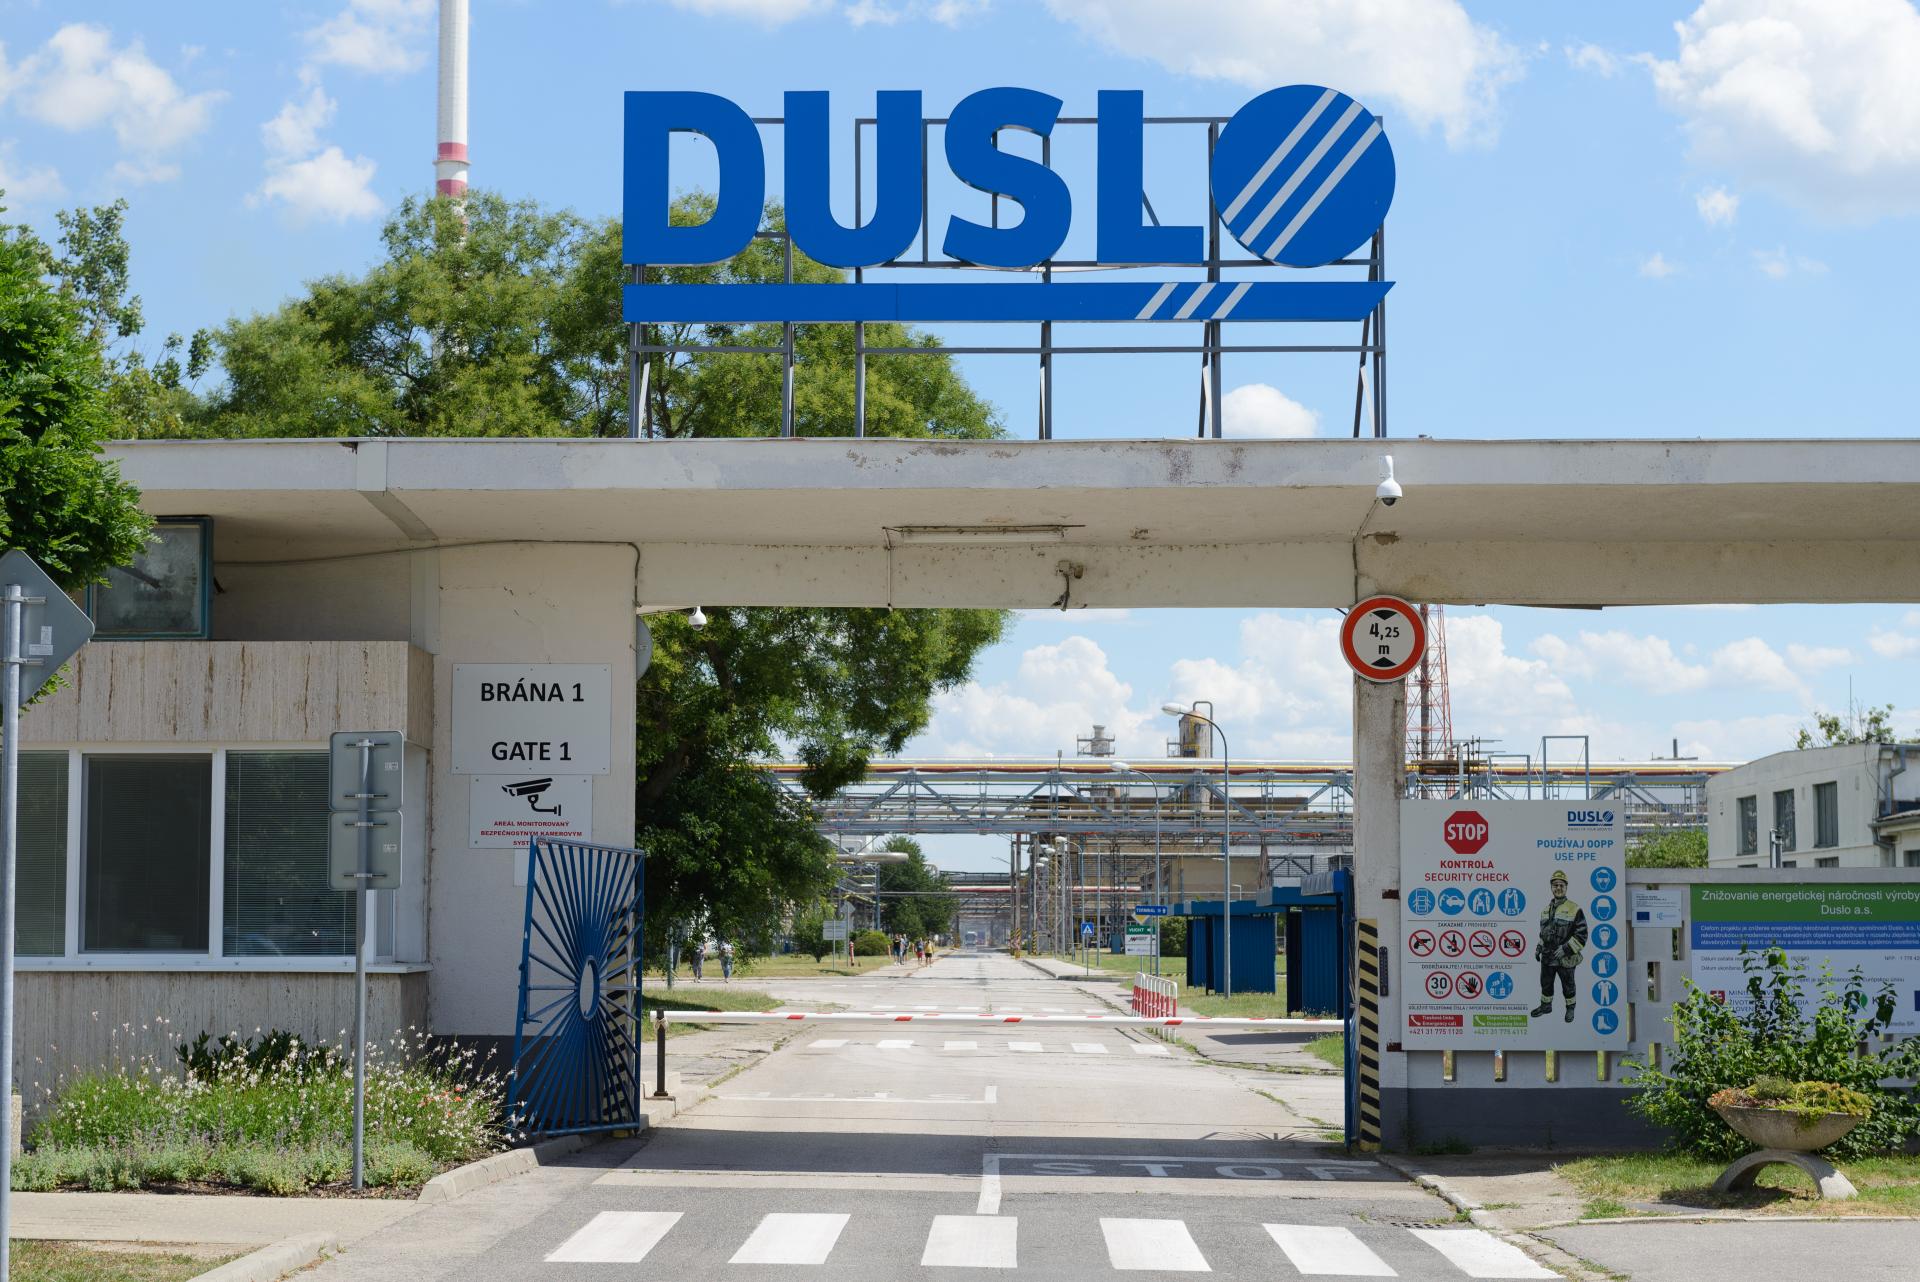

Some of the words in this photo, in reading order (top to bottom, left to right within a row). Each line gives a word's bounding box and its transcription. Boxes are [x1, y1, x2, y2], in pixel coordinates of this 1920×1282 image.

[623, 84, 1396, 267] DUSLO
[1369, 622, 1400, 641] 4,25
[1378, 645, 1390, 655] m
[481, 677, 564, 702] BRÁNA
[572, 683, 584, 702] 1
[491, 741, 551, 761] GATE
[560, 742, 572, 761] 1
[1567, 810, 1614, 823] DUSLO
[1447, 823, 1487, 841] STOP
[1536, 837, 1585, 849] POUŽÍVAJ
[1587, 839, 1614, 848] OOPP
[1554, 852, 1575, 861] USE
[1577, 852, 1597, 861] PPE
[1440, 860, 1495, 869] KONTROLA
[1424, 873, 1473, 882] SECURITY
[1475, 873, 1510, 882] CHECK
[1701, 890, 1759, 901] Znižovanie
[1762, 890, 1825, 903] energetickej
[1828, 890, 1883, 901] náročnosti
[1885, 890, 1920, 903] výroby
[1821, 904, 1850, 915] Duslo
[1854, 906, 1873, 915] a.s.
[1431, 977, 1448, 990] 30
[1033, 1162, 1371, 1181] STOP
